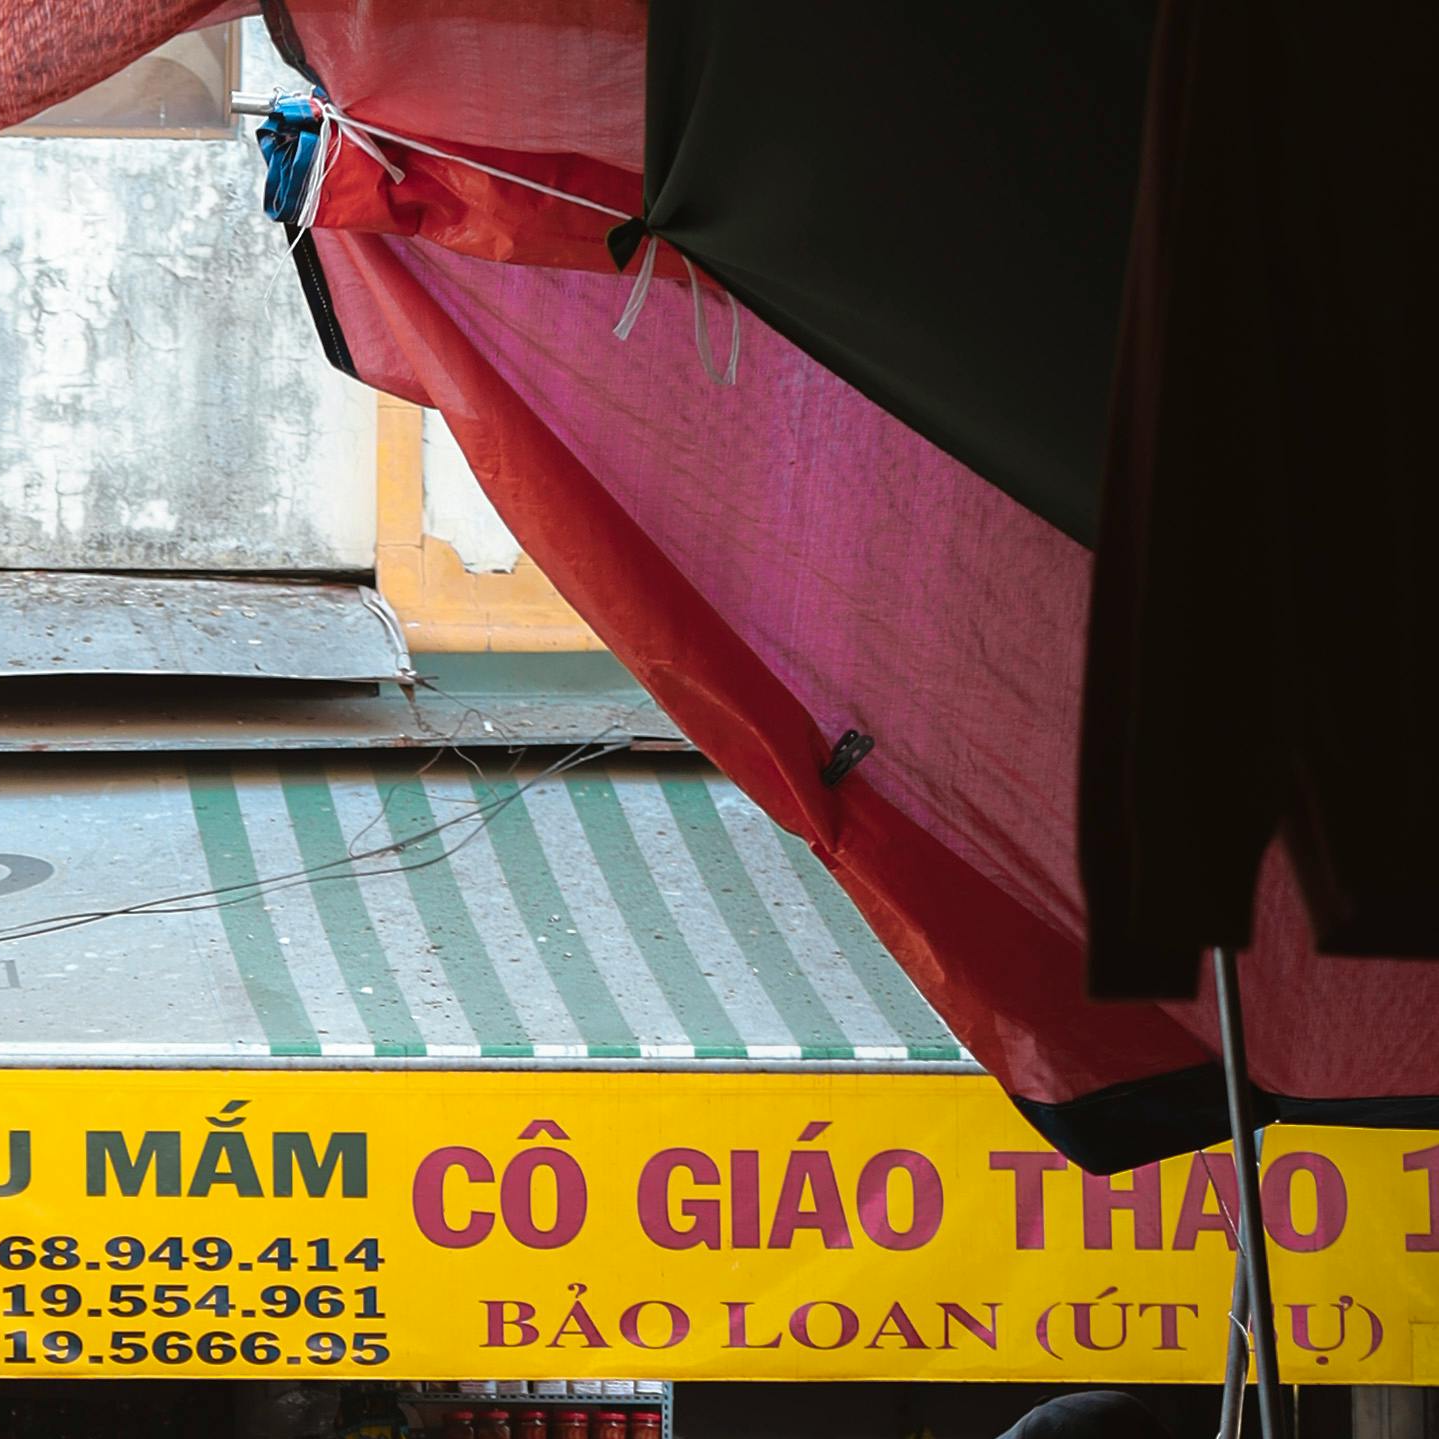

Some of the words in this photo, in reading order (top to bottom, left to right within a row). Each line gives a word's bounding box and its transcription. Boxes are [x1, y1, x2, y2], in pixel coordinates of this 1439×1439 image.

[85, 1099, 368, 1199] MẮM
[411, 1119, 588, 1250] CÔ
[636, 1121, 945, 1251] GIÁO
[478, 1282, 613, 1350] BẢO
[720, 1300, 1003, 1350] LOAN
[1248, 1295, 1385, 1366] Ự)
